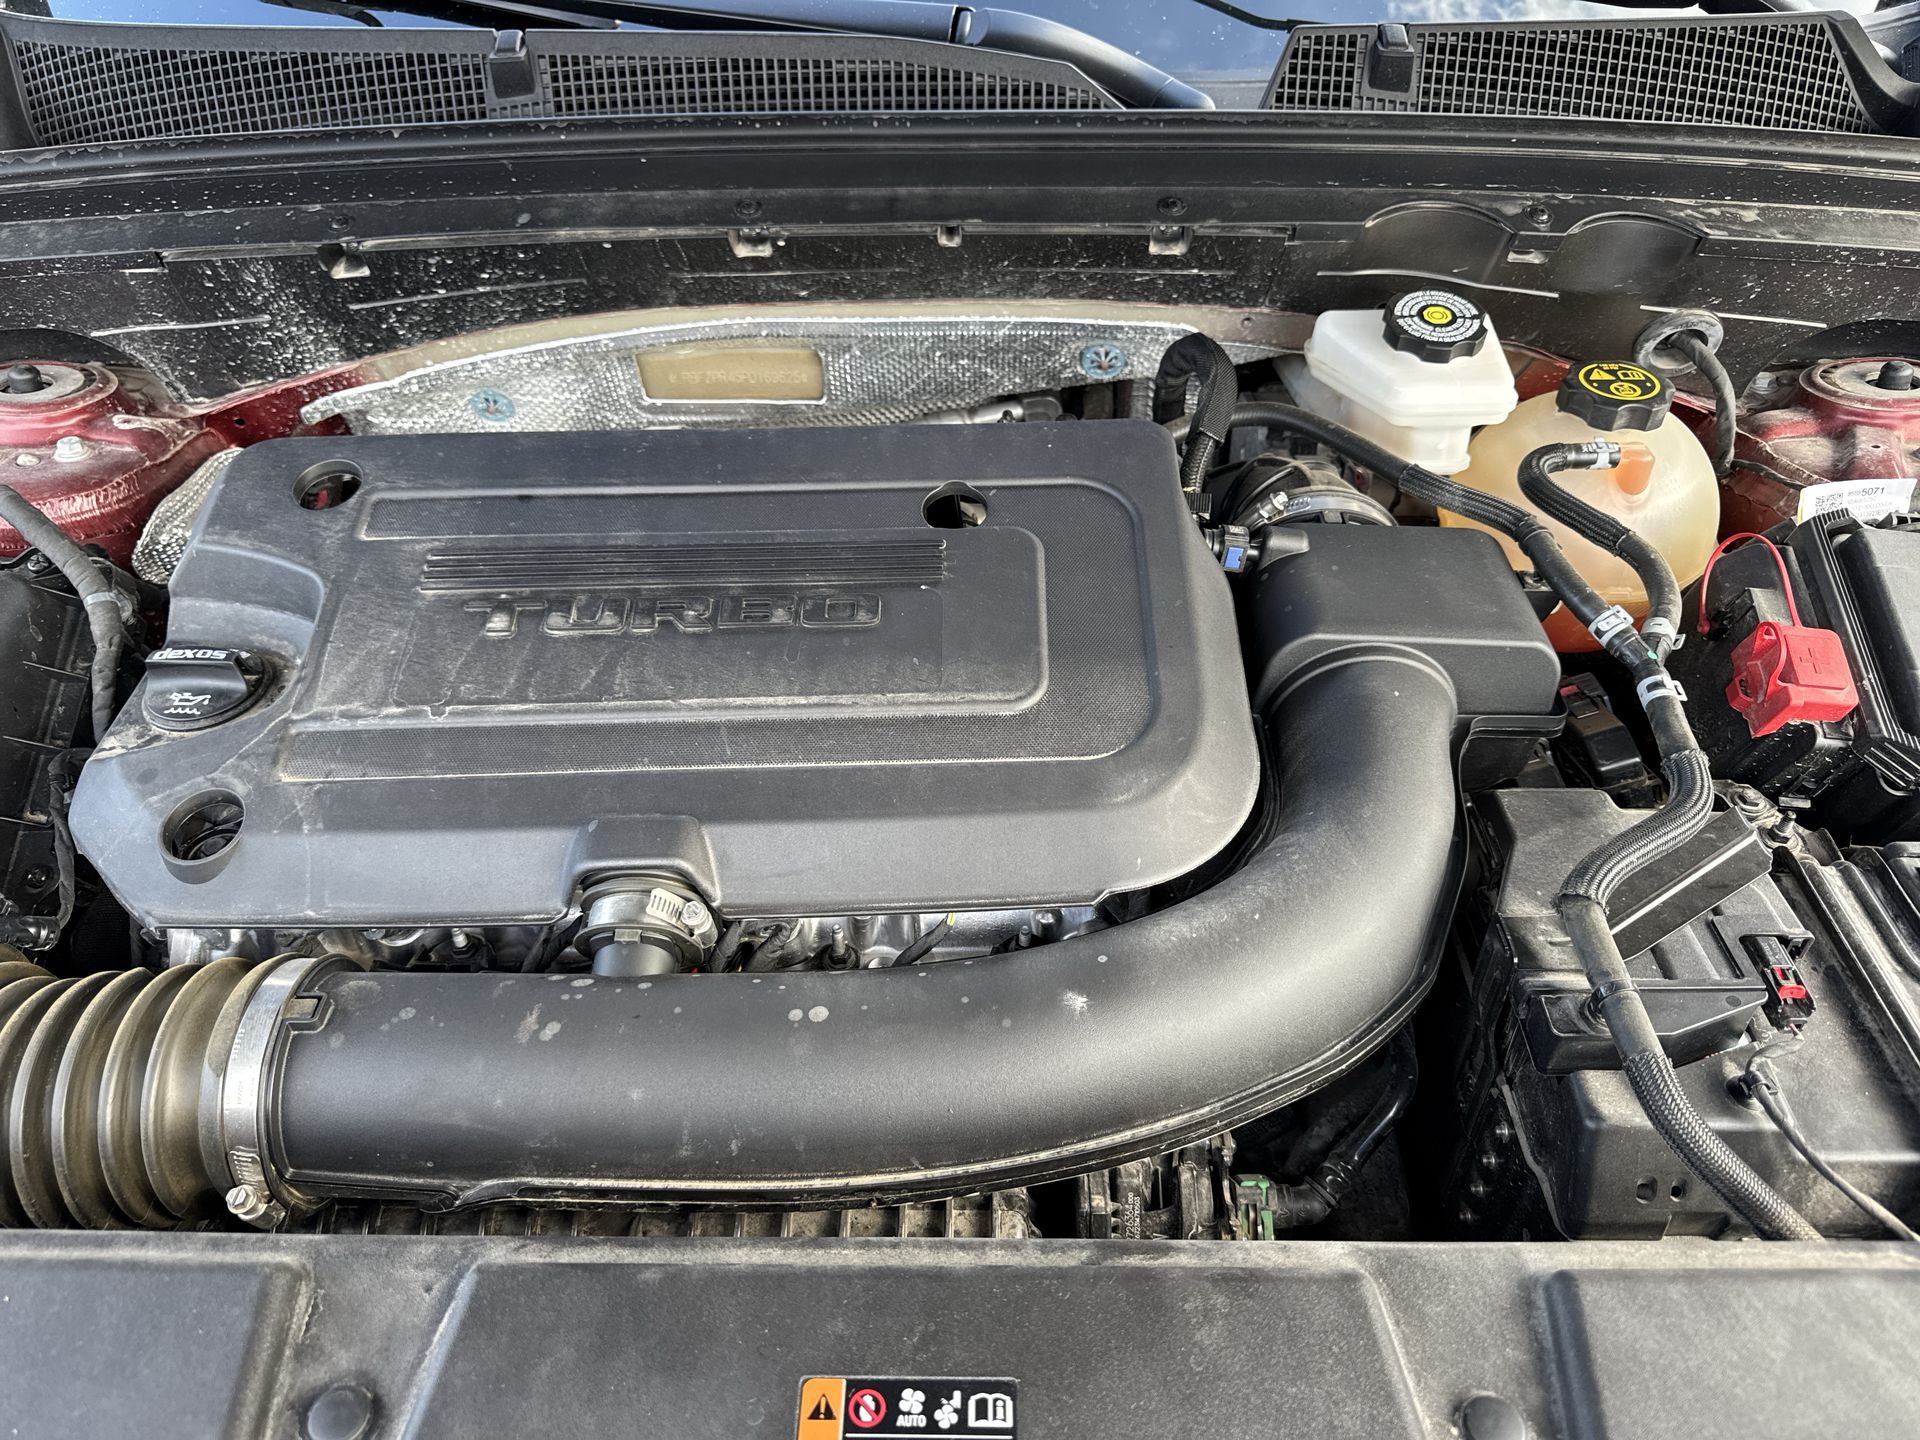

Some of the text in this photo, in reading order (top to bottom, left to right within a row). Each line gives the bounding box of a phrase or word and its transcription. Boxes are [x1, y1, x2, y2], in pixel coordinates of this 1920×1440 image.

[463, 594, 881, 638] TURBO
[153, 648, 229, 660] dexos
[896, 1415, 927, 1427] AUTO
